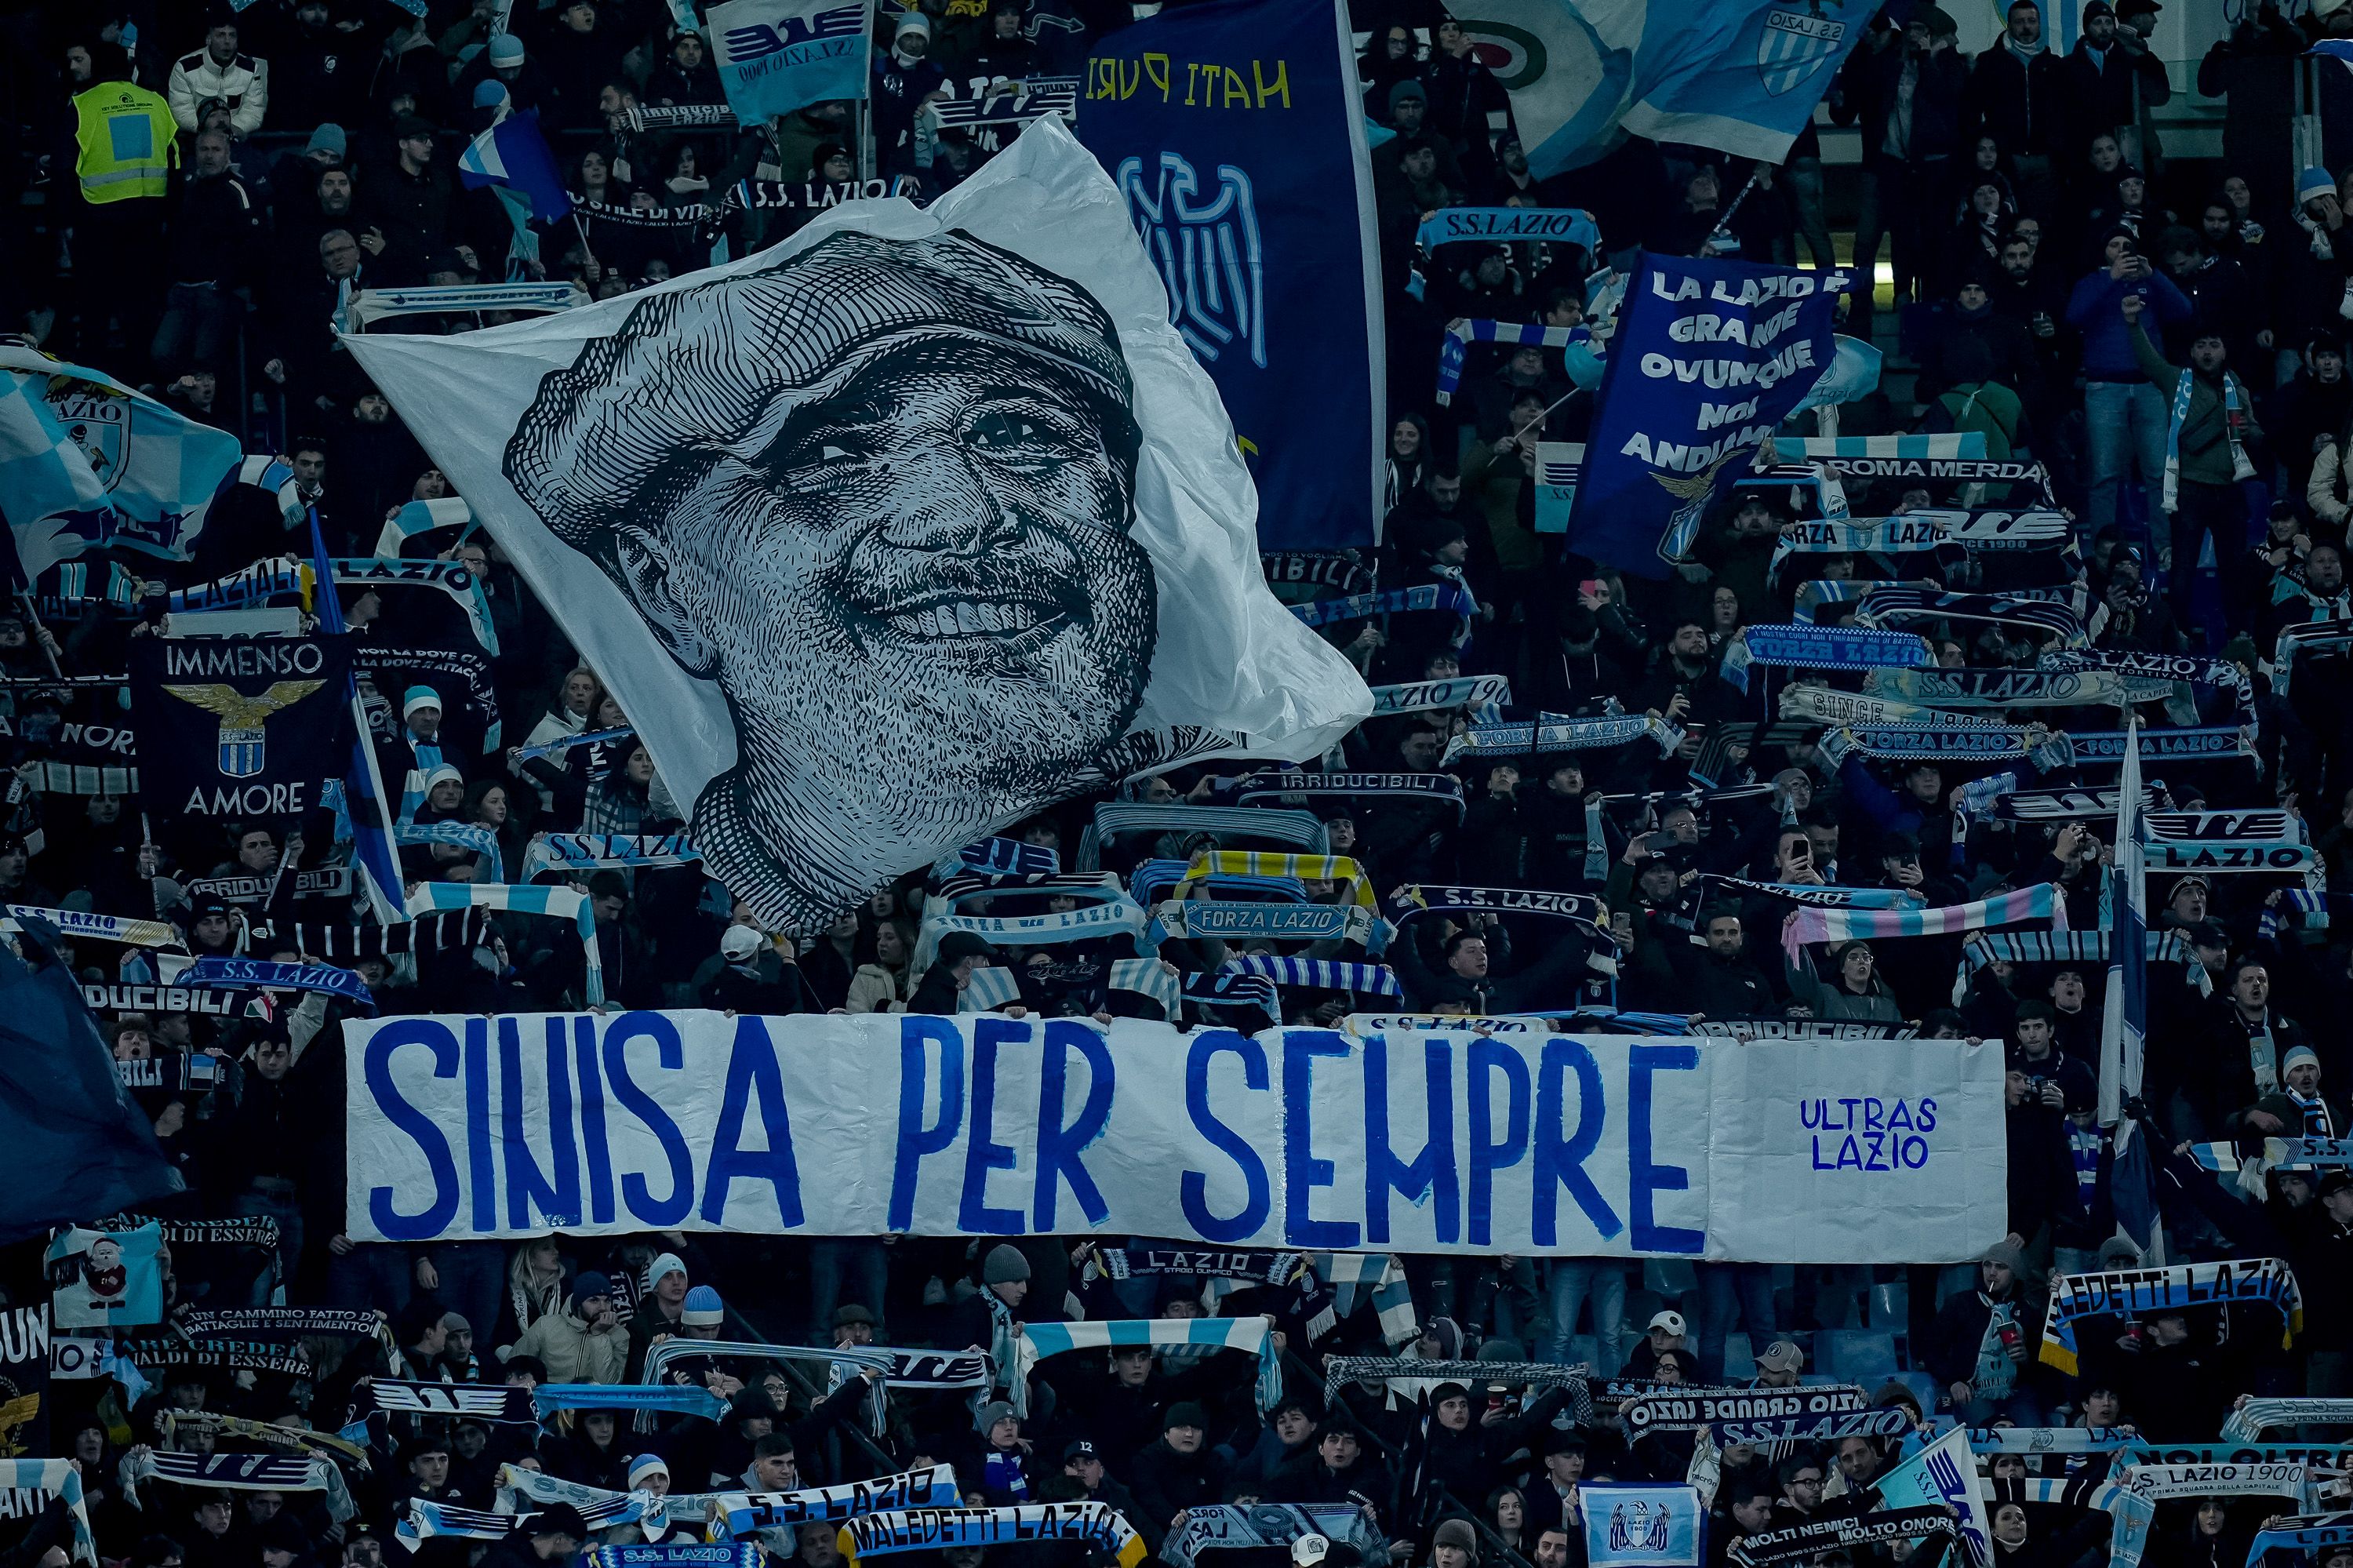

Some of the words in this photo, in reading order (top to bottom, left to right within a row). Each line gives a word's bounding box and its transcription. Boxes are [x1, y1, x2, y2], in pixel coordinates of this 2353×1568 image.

[756, 182, 795, 207] S.S.
[806, 179, 887, 207] LAZIO
[1653, 271, 1702, 302] LA
[1711, 275, 1815, 308] LAZIO
[1668, 300, 1803, 349] GRANDE
[1640, 339, 1817, 390] OVUNQUE
[56, 400, 122, 421] AZIO
[1697, 395, 1760, 431] NOI
[1826, 460, 1927, 478] ROMA
[1930, 461, 2042, 484] MERDA
[337, 560, 471, 591] LAZIO
[165, 642, 323, 676] IMMENSO
[2099, 653, 2196, 675] LAZIO
[1380, 681, 1453, 708] AZIO
[1813, 693, 1884, 722] SINCE
[60, 722, 136, 755] NOR
[238, 733, 263, 742] LAZIO
[1474, 726, 1560, 746] FORZA
[1566, 719, 1646, 742] LAZIO
[1866, 732, 1937, 750] FORZA
[1941, 733, 2008, 751] LAZIO
[2087, 737, 2155, 755] FORA
[2159, 735, 2224, 753] LAZIO
[1280, 775, 1437, 791] IRRIDUCIBILI
[183, 781, 305, 816] AMORE
[549, 834, 597, 862] S.S.
[2166, 847, 2304, 868] LAZIO
[193, 871, 336, 897] IRRIDUBILI
[1445, 888, 1494, 907] S.S.
[1502, 891, 1580, 914] LAZIO
[60, 911, 117, 930] LAZIO
[937, 917, 1006, 933] FORZA
[1060, 904, 1124, 927] LAZIO
[1202, 910, 1265, 928] FORZA
[1271, 911, 1333, 929] LAZIO
[221, 961, 260, 979] S.S.
[271, 964, 347, 989] LAZIO
[81, 984, 235, 1015] DUCIBILI
[1800, 1097, 1937, 1133] ULTRAS
[363, 1010, 806, 1241] SINISA
[886, 1015, 1115, 1235] PER
[1180, 1028, 1705, 1254] SEMPRE
[1812, 1131, 1929, 1171] LAZIO
[2304, 1139, 2348, 1156] S.S.
[1147, 1250, 1250, 1271] LAZIO
[185, 1319, 260, 1336] BATTAGLIE
[264, 1319, 271, 1328] E
[220, 1309, 305, 1319] CAMMINO
[309, 1309, 356, 1320] FATTO
[1079, 1441, 1093, 1453] 12
[2168, 1465, 2238, 1484] LAZIO
[2246, 1464, 2304, 1483] 1900
[1742, 1527, 1797, 1550] MOLTI
[1799, 1517, 1860, 1537] NEMICI
[1838, 1521, 1897, 1542] MOLTO
[624, 1549, 664, 1562] S.S.
[668, 1548, 732, 1562] LAZIO
